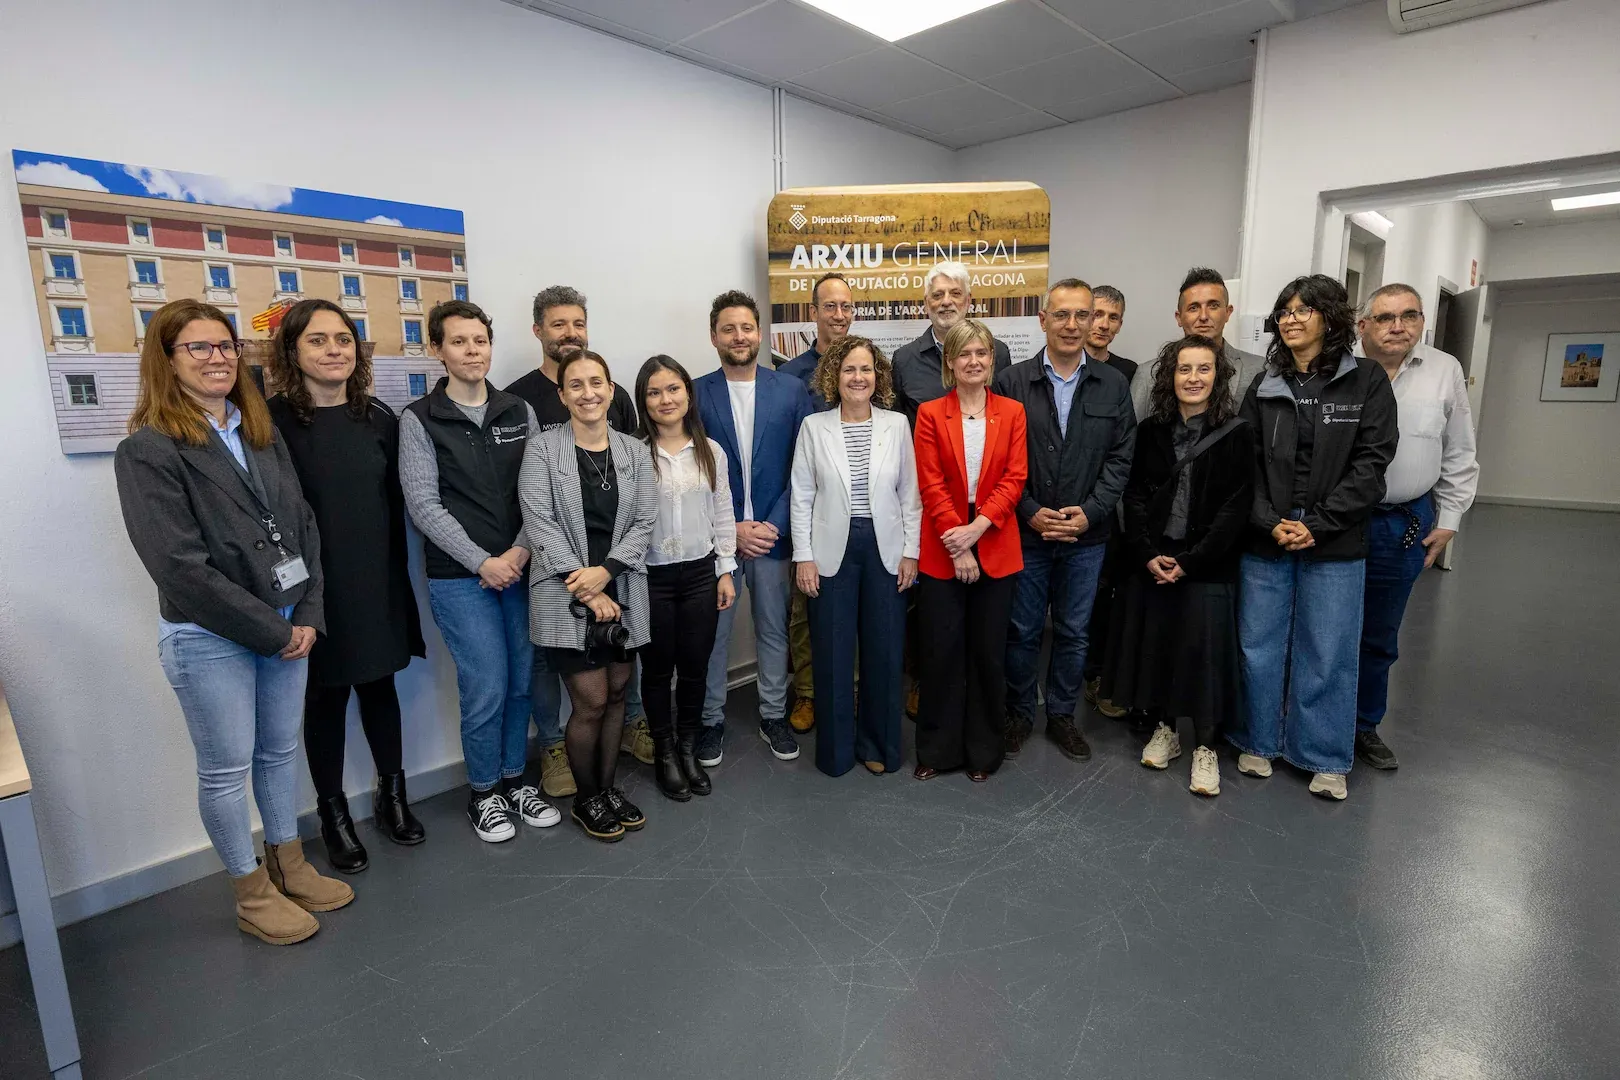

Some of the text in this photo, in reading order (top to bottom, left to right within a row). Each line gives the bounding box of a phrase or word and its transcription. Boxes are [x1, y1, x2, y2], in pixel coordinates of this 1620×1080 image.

[811, 214, 896, 225] Diputació Tarragona
[789, 238, 1025, 270] ARXIU GENERAL
[789, 278, 808, 291] DE
[878, 305, 893, 316] DE
